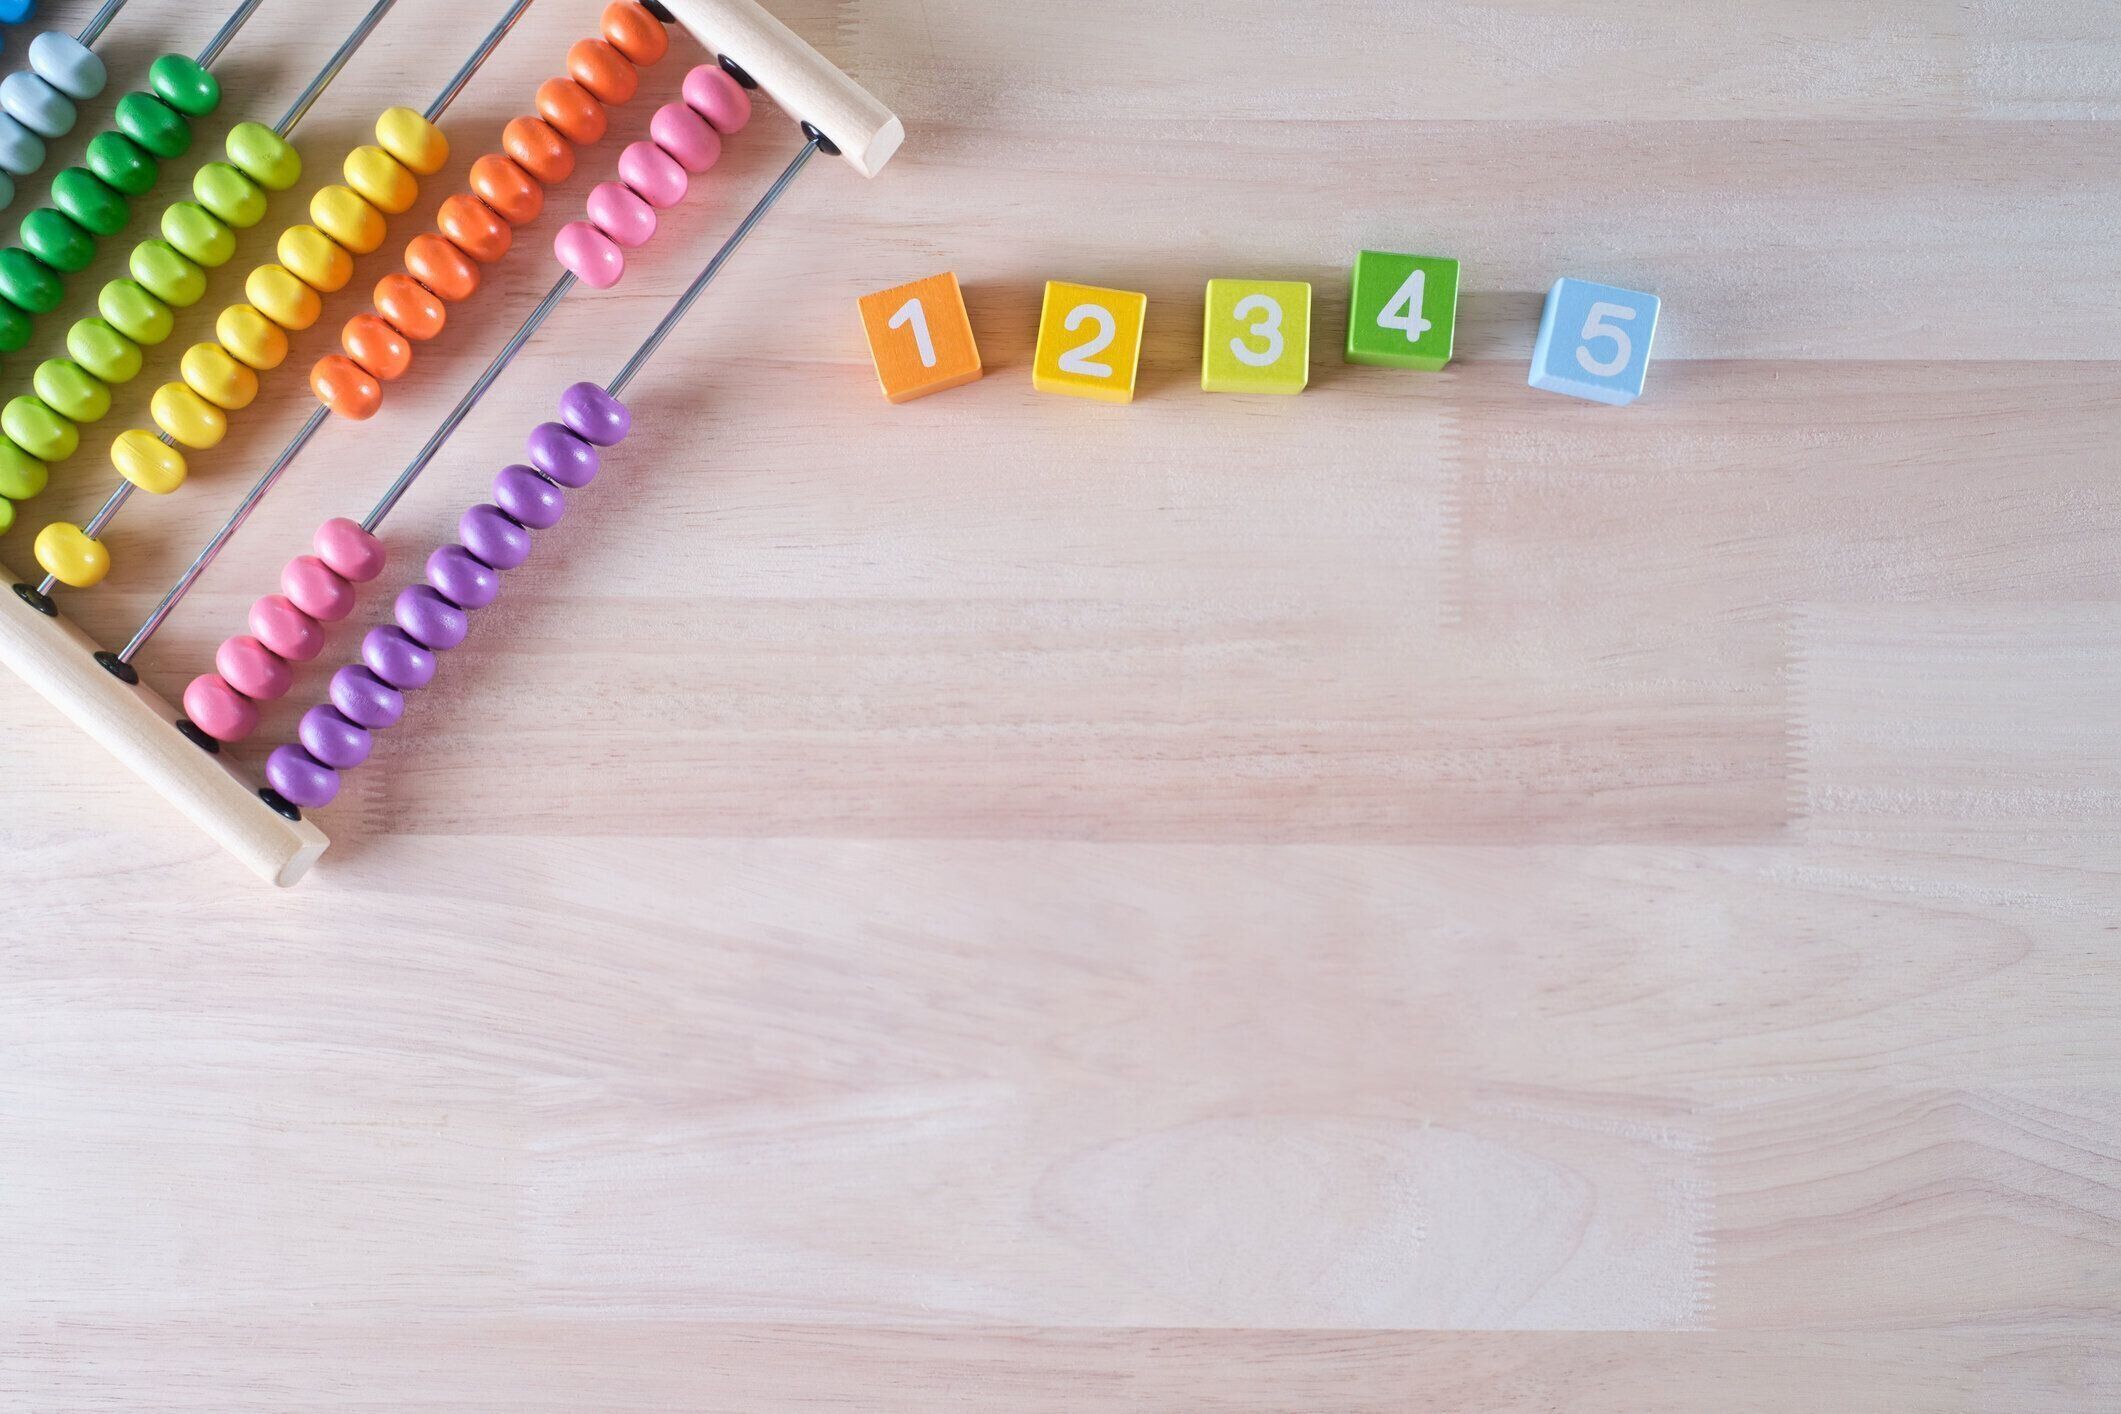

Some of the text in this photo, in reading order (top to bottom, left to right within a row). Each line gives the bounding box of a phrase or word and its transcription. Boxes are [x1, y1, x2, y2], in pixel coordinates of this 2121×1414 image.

[888, 298, 936, 368] 1
[1057, 303, 1117, 378] 2
[1229, 294, 1285, 367] 3
[1376, 269, 1431, 343] 4
[1575, 302, 1637, 377] 5
